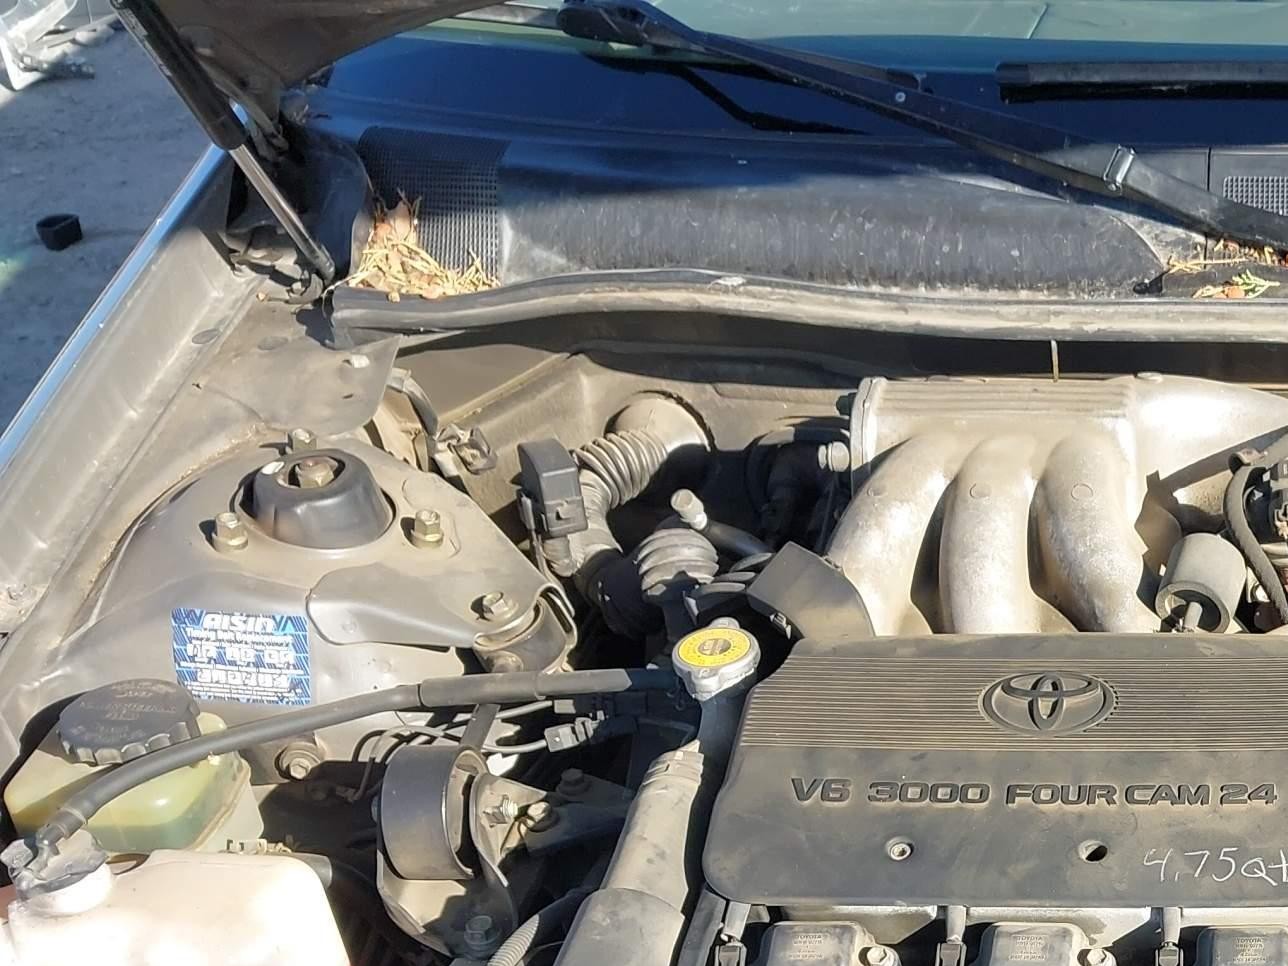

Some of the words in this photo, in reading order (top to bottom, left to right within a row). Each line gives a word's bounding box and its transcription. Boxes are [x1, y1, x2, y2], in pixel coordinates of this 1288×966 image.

[790, 777, 851, 803] V6
[867, 781, 991, 805] 3000
[1005, 783, 1118, 806] FOUR
[1124, 783, 1210, 807] CAM
[1219, 783, 1278, 805] 24
